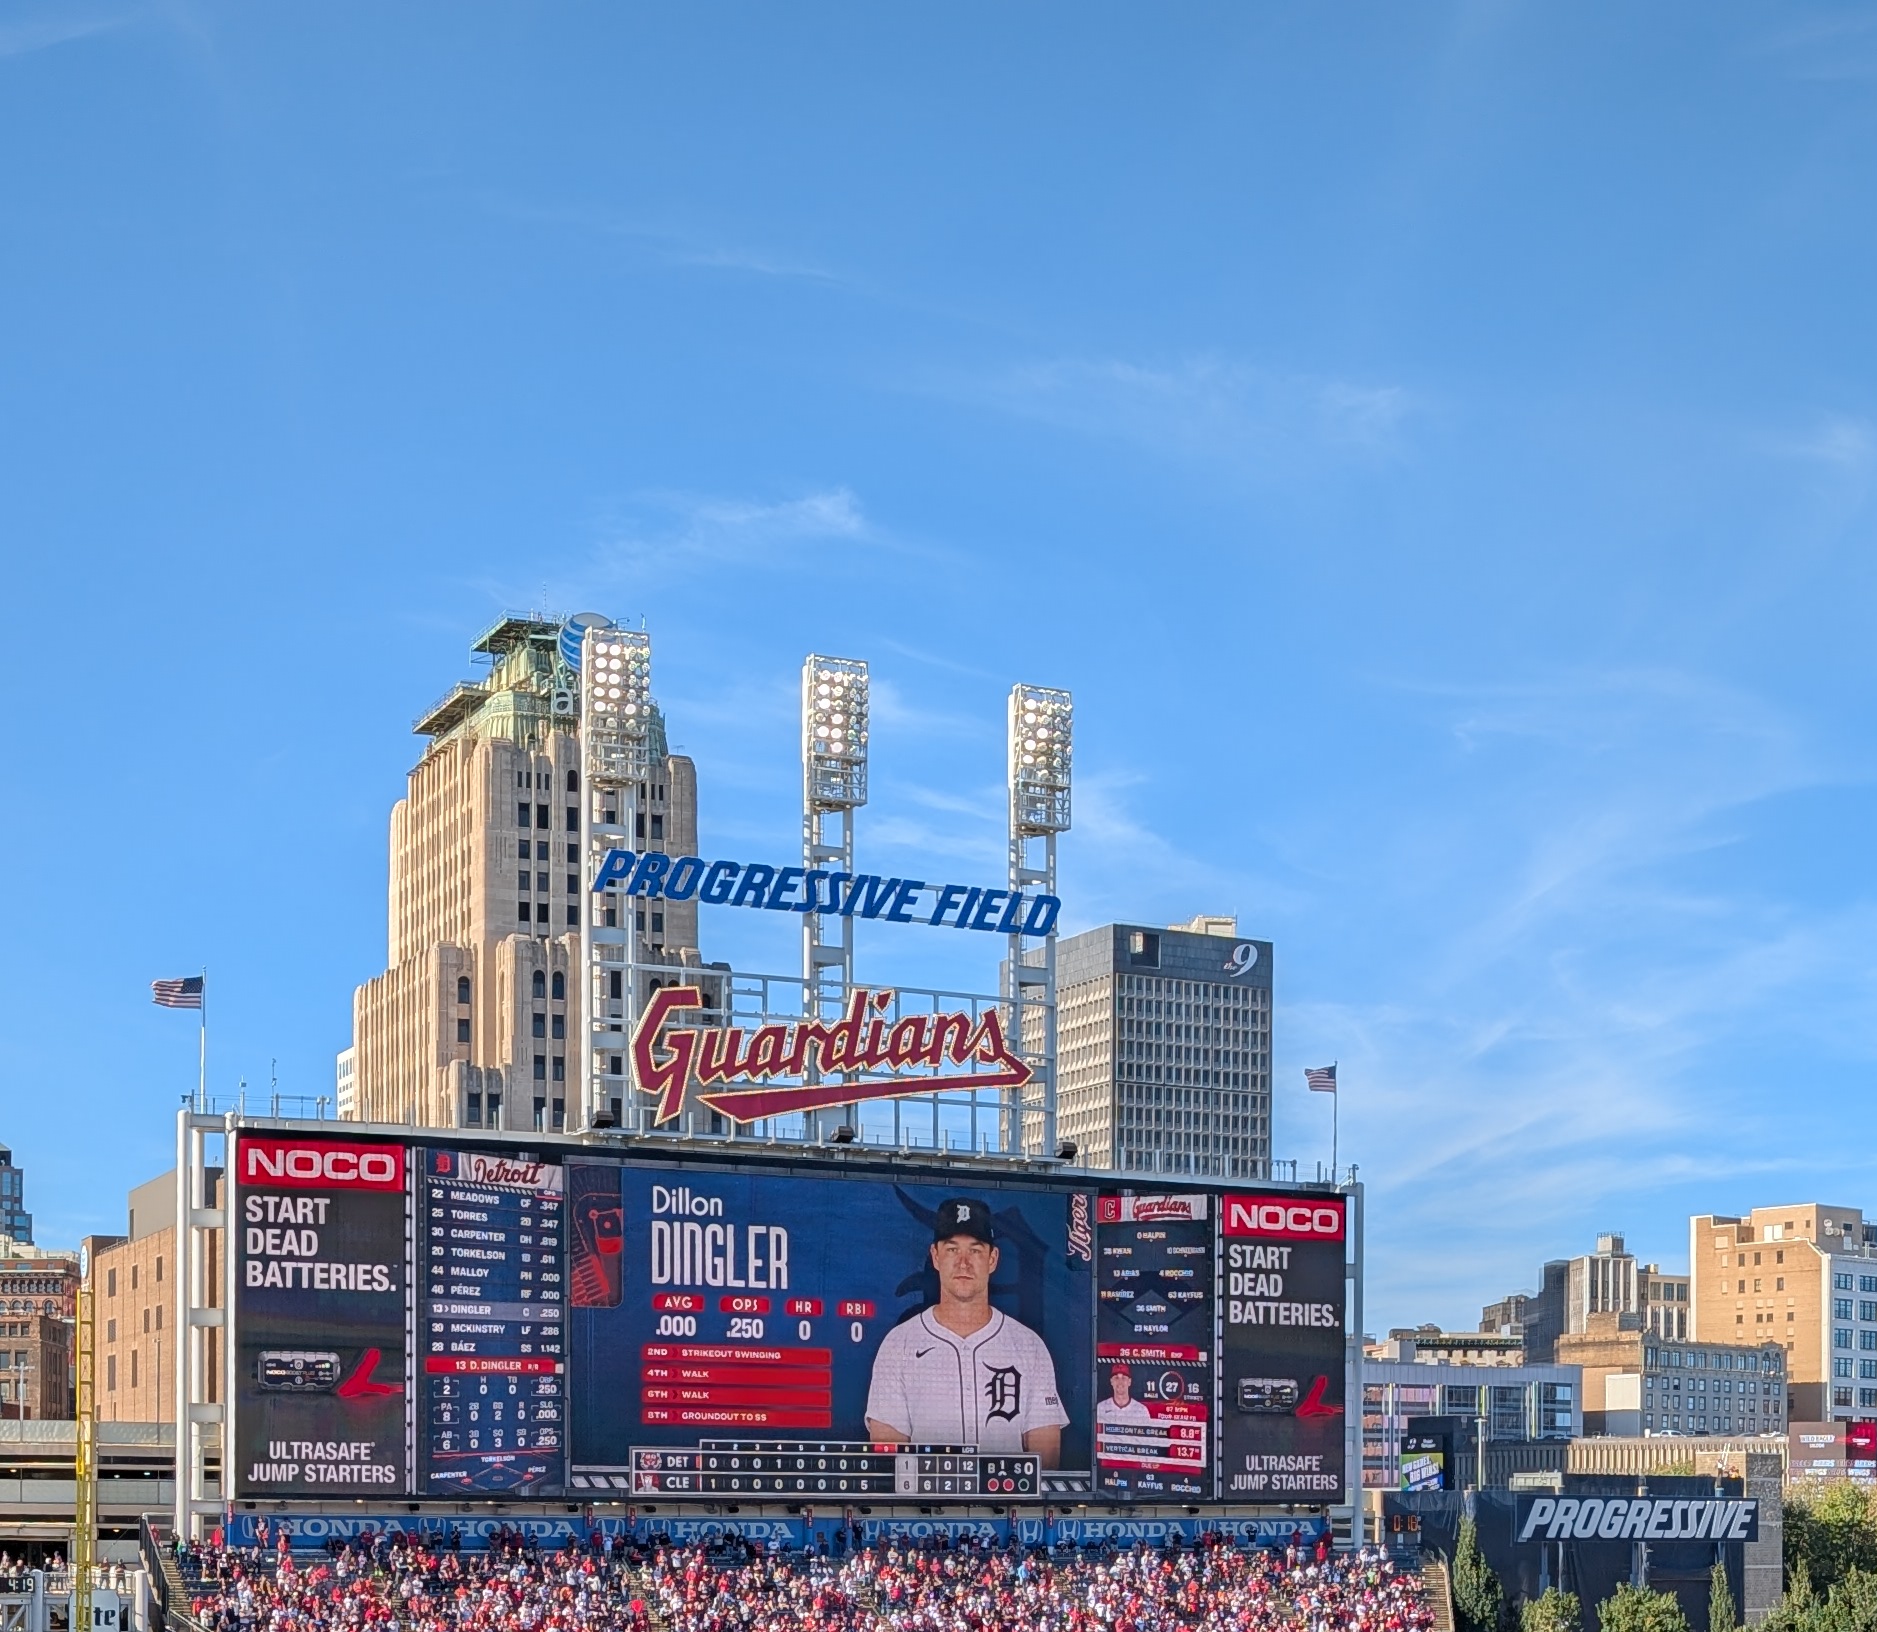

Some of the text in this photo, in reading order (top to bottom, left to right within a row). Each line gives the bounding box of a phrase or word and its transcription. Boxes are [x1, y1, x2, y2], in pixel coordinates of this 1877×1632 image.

[594, 848, 1062, 937] PROGRESSIVE FIELD
[1230, 944, 1258, 977] 9
[631, 986, 1033, 1124] Guardians
[247, 1148, 395, 1182] NOCO
[474, 1158, 546, 1185] Detroit
[451, 1191, 500, 1205] MEADOWS
[652, 1185, 723, 1217] Dillon
[245, 1195, 331, 1225] START
[451, 1209, 488, 1221] TORRES
[1132, 1195, 1193, 1221] Guardians
[1230, 1203, 1339, 1233] NOCO
[246, 1227, 319, 1257] DEAD
[451, 1228, 505, 1242] CARPENTER
[451, 1248, 505, 1260] TORKELSON
[651, 1220, 788, 1290] DINGLER
[1229, 1244, 1292, 1270] START
[246, 1260, 397, 1291] BATTERIES.
[451, 1266, 489, 1277] MALLOY
[451, 1283, 481, 1296] PÉREZ
[1229, 1272, 1283, 1297] DEAD
[451, 1304, 491, 1315] DINGLER
[664, 1296, 692, 1308] AVG
[732, 1298, 759, 1311] OPS
[795, 1301, 812, 1313] HR
[846, 1303, 866, 1315] RBI
[1229, 1300, 1340, 1327] BATTERIES.
[451, 1324, 505, 1334] MCKINSTRY
[655, 1315, 863, 1342] .000 .250 0 0
[682, 1349, 781, 1360] STRIKEOUT SWINGING
[1141, 1349, 1166, 1358] SMITH
[455, 1361, 522, 1371] 13 DINGLER
[647, 1369, 709, 1378] 4TH WALK
[536, 1385, 557, 1394] .250
[682, 1391, 710, 1399] WALK
[1146, 1381, 1199, 1394] 11 27 16
[682, 1412, 740, 1421] GROUNDOUT
[269, 1440, 372, 1460] ULTRASAFE
[667, 1456, 689, 1468] DET
[962, 1461, 974, 1471] 12
[1245, 1455, 1320, 1471] ULTRASAFE
[248, 1463, 396, 1483] JUMP STARTERS
[666, 1477, 690, 1489] CLE
[1230, 1474, 1338, 1490] JUMP STARTERS
[284, 1519, 407, 1537] HONDA
[450, 1520, 579, 1537] HONDA
[1517, 1499, 1756, 1542] PROGRESSIVE
[674, 1522, 795, 1538] HONDA
[886, 1522, 998, 1538] HONDA
[1084, 1521, 1187, 1538] HONDA
